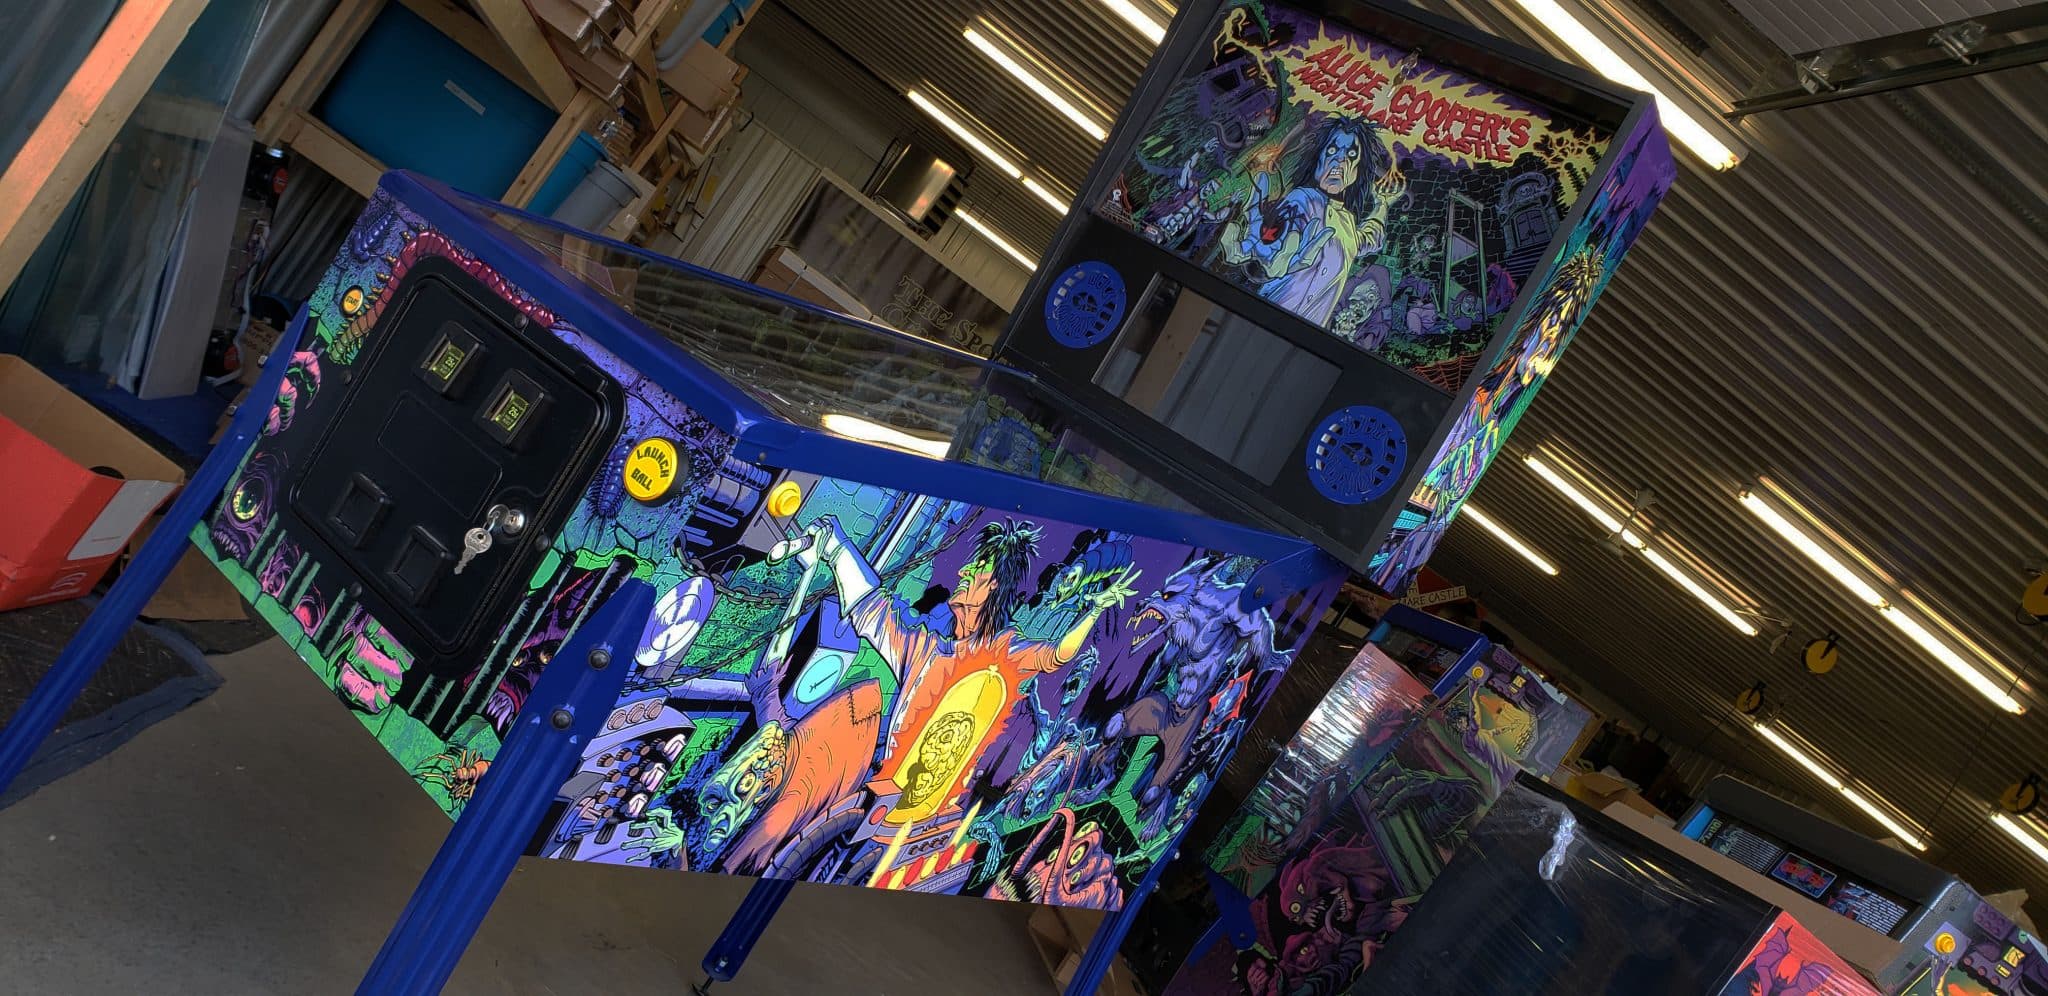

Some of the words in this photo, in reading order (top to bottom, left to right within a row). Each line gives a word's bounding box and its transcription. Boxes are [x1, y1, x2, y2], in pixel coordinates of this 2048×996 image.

[1292, 65, 1416, 136] NIGHTMARE
[1423, 127, 1513, 163] CASTLE
[1303, 44, 1389, 100] ALICE
[1390, 84, 1532, 149] COOPER'S
[897, 274, 953, 330] THE
[631, 467, 653, 491] BALL
[637, 446, 670, 478] LAUNCH
[1428, 587, 1465, 604] CASTLE
